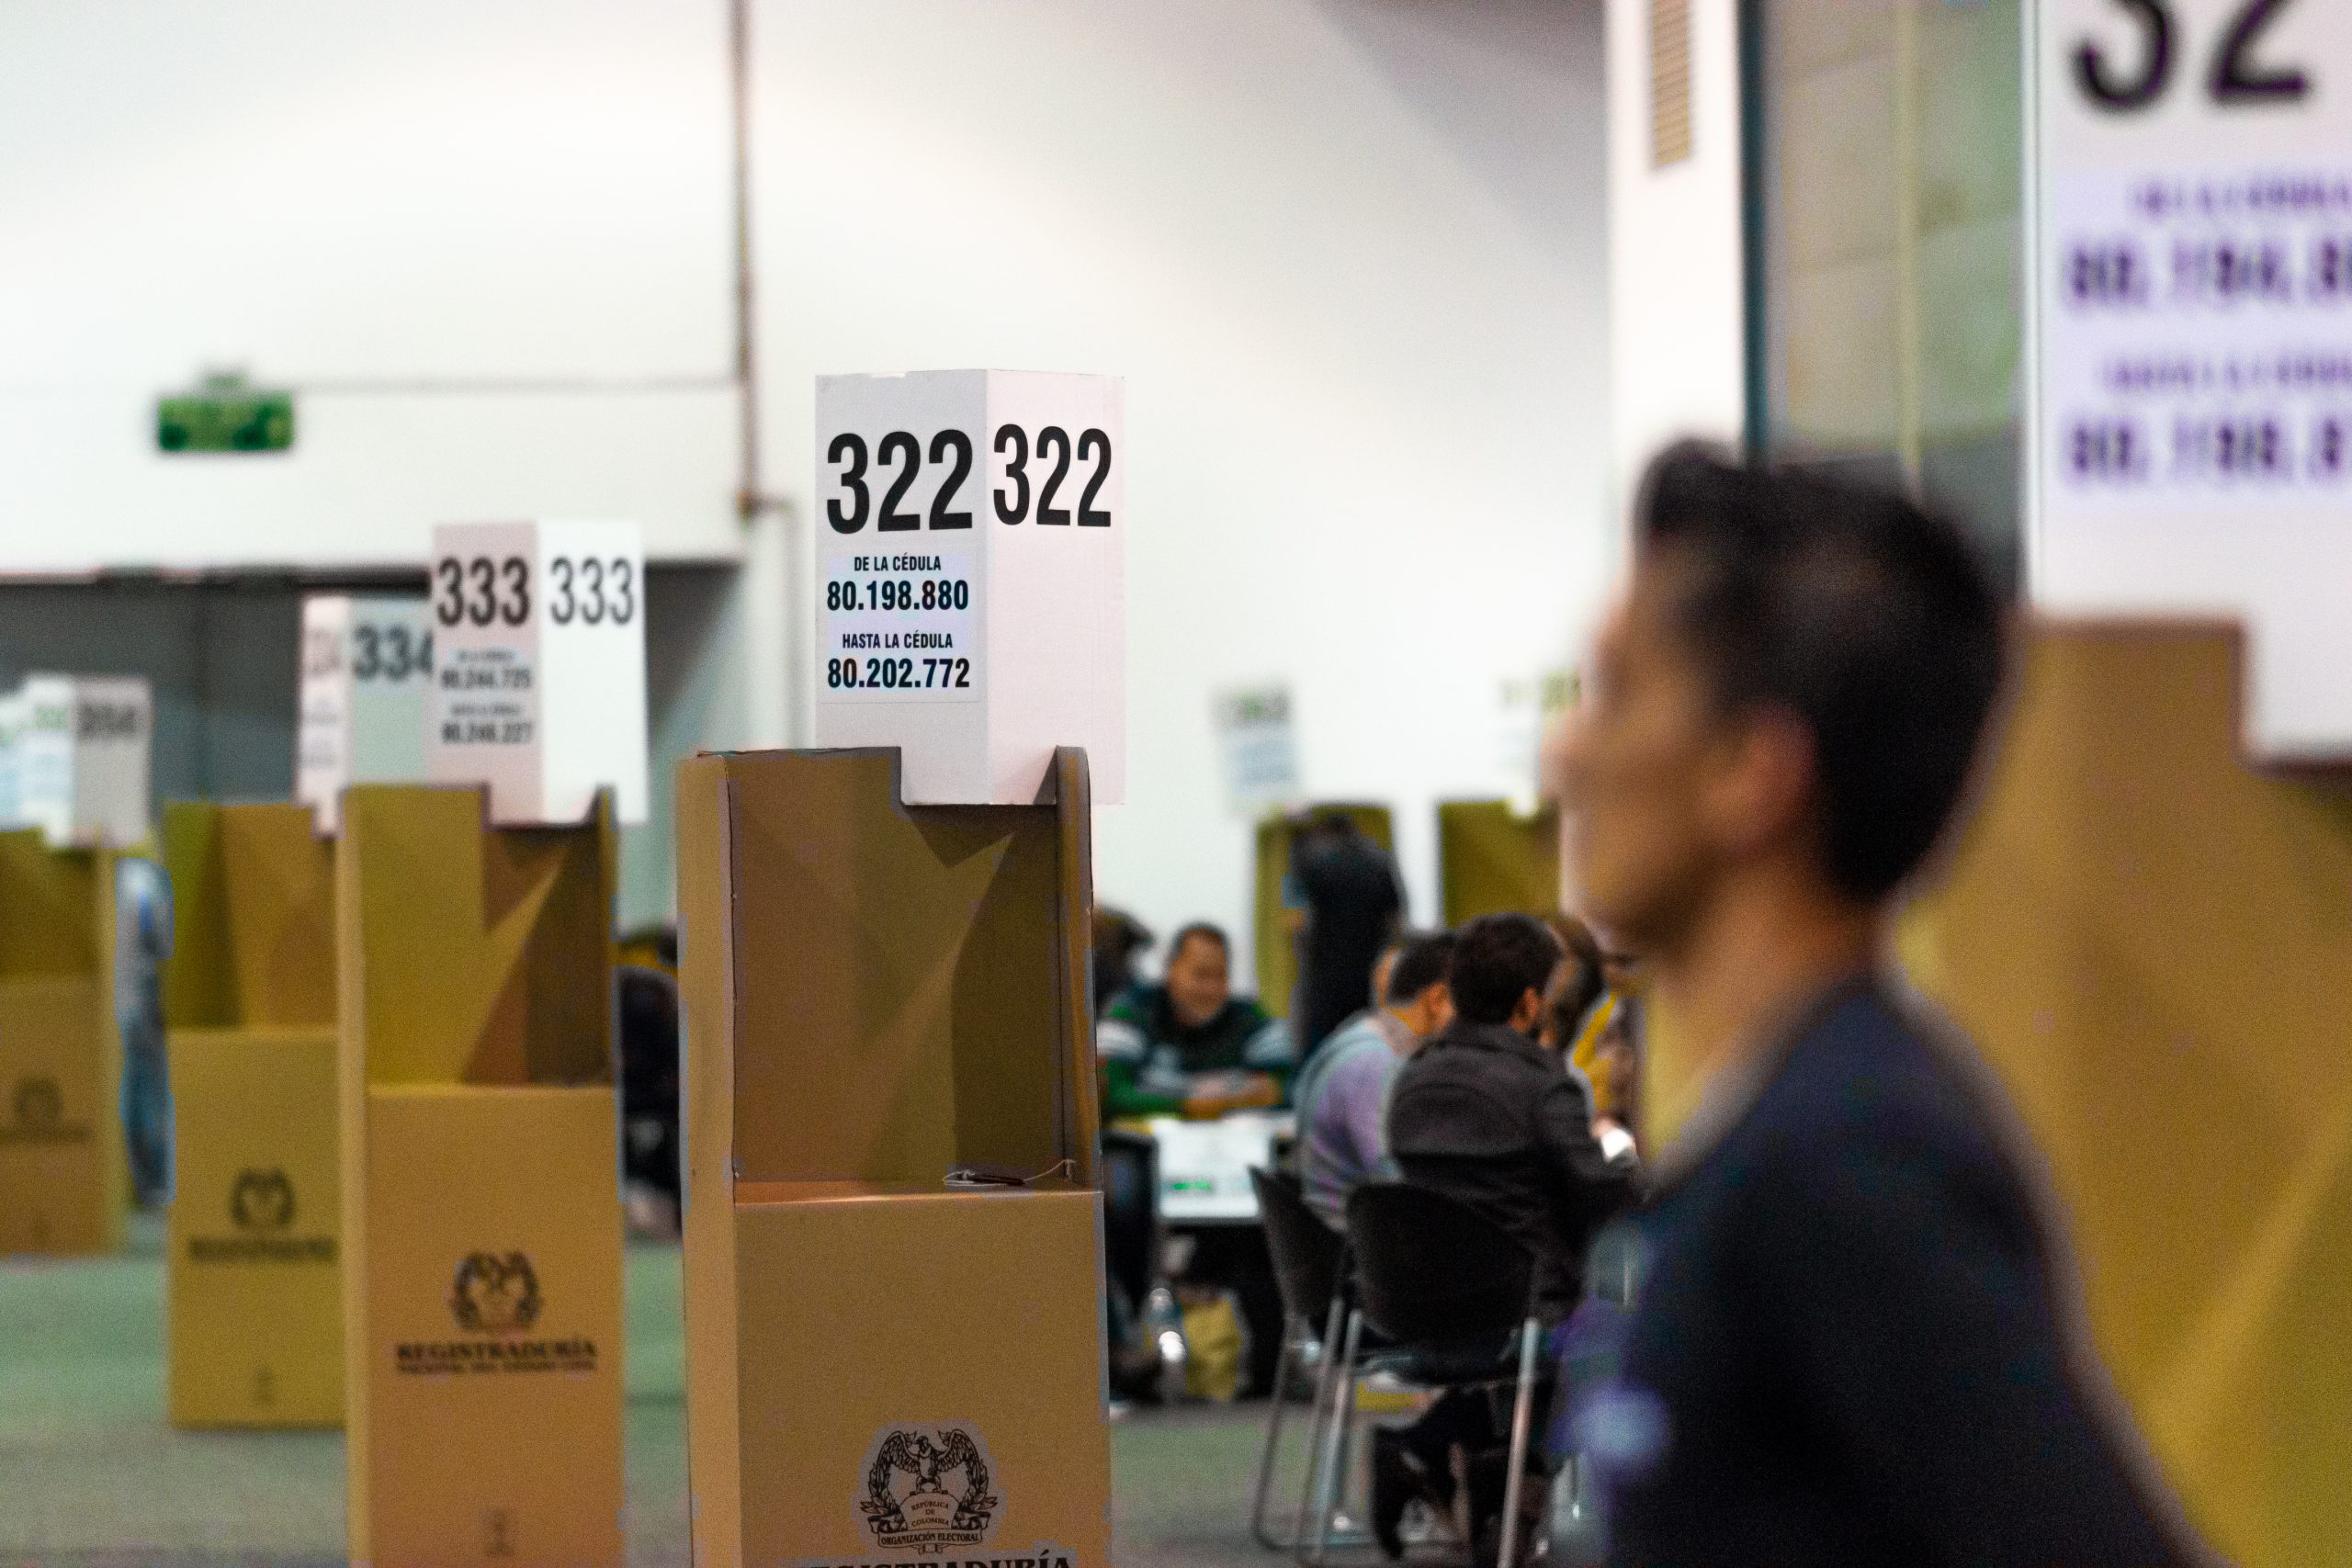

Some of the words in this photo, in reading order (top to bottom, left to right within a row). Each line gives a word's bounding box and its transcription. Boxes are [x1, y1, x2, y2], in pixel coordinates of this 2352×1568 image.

[827, 428, 973, 535] 322
[993, 423, 1112, 527] 322
[854, 556, 869, 571] DE
[874, 556, 888, 571] LA
[892, 552, 942, 571] CÉDULA
[437, 557, 531, 626] 333
[550, 557, 634, 626] 333
[827, 580, 969, 611] 80.198.880
[842, 633, 881, 649] HASTA
[885, 634, 900, 649] LA
[904, 629, 953, 649] CÉDULA
[828, 658, 970, 688] 80.202.772
[910, 1500, 949, 1511] REPÚBLICA
[911, 1517, 949, 1527] COLOMBIA
[881, 1531, 936, 1544] ORGANIZACIÓN
[937, 1532, 980, 1542] ELECTORAL
